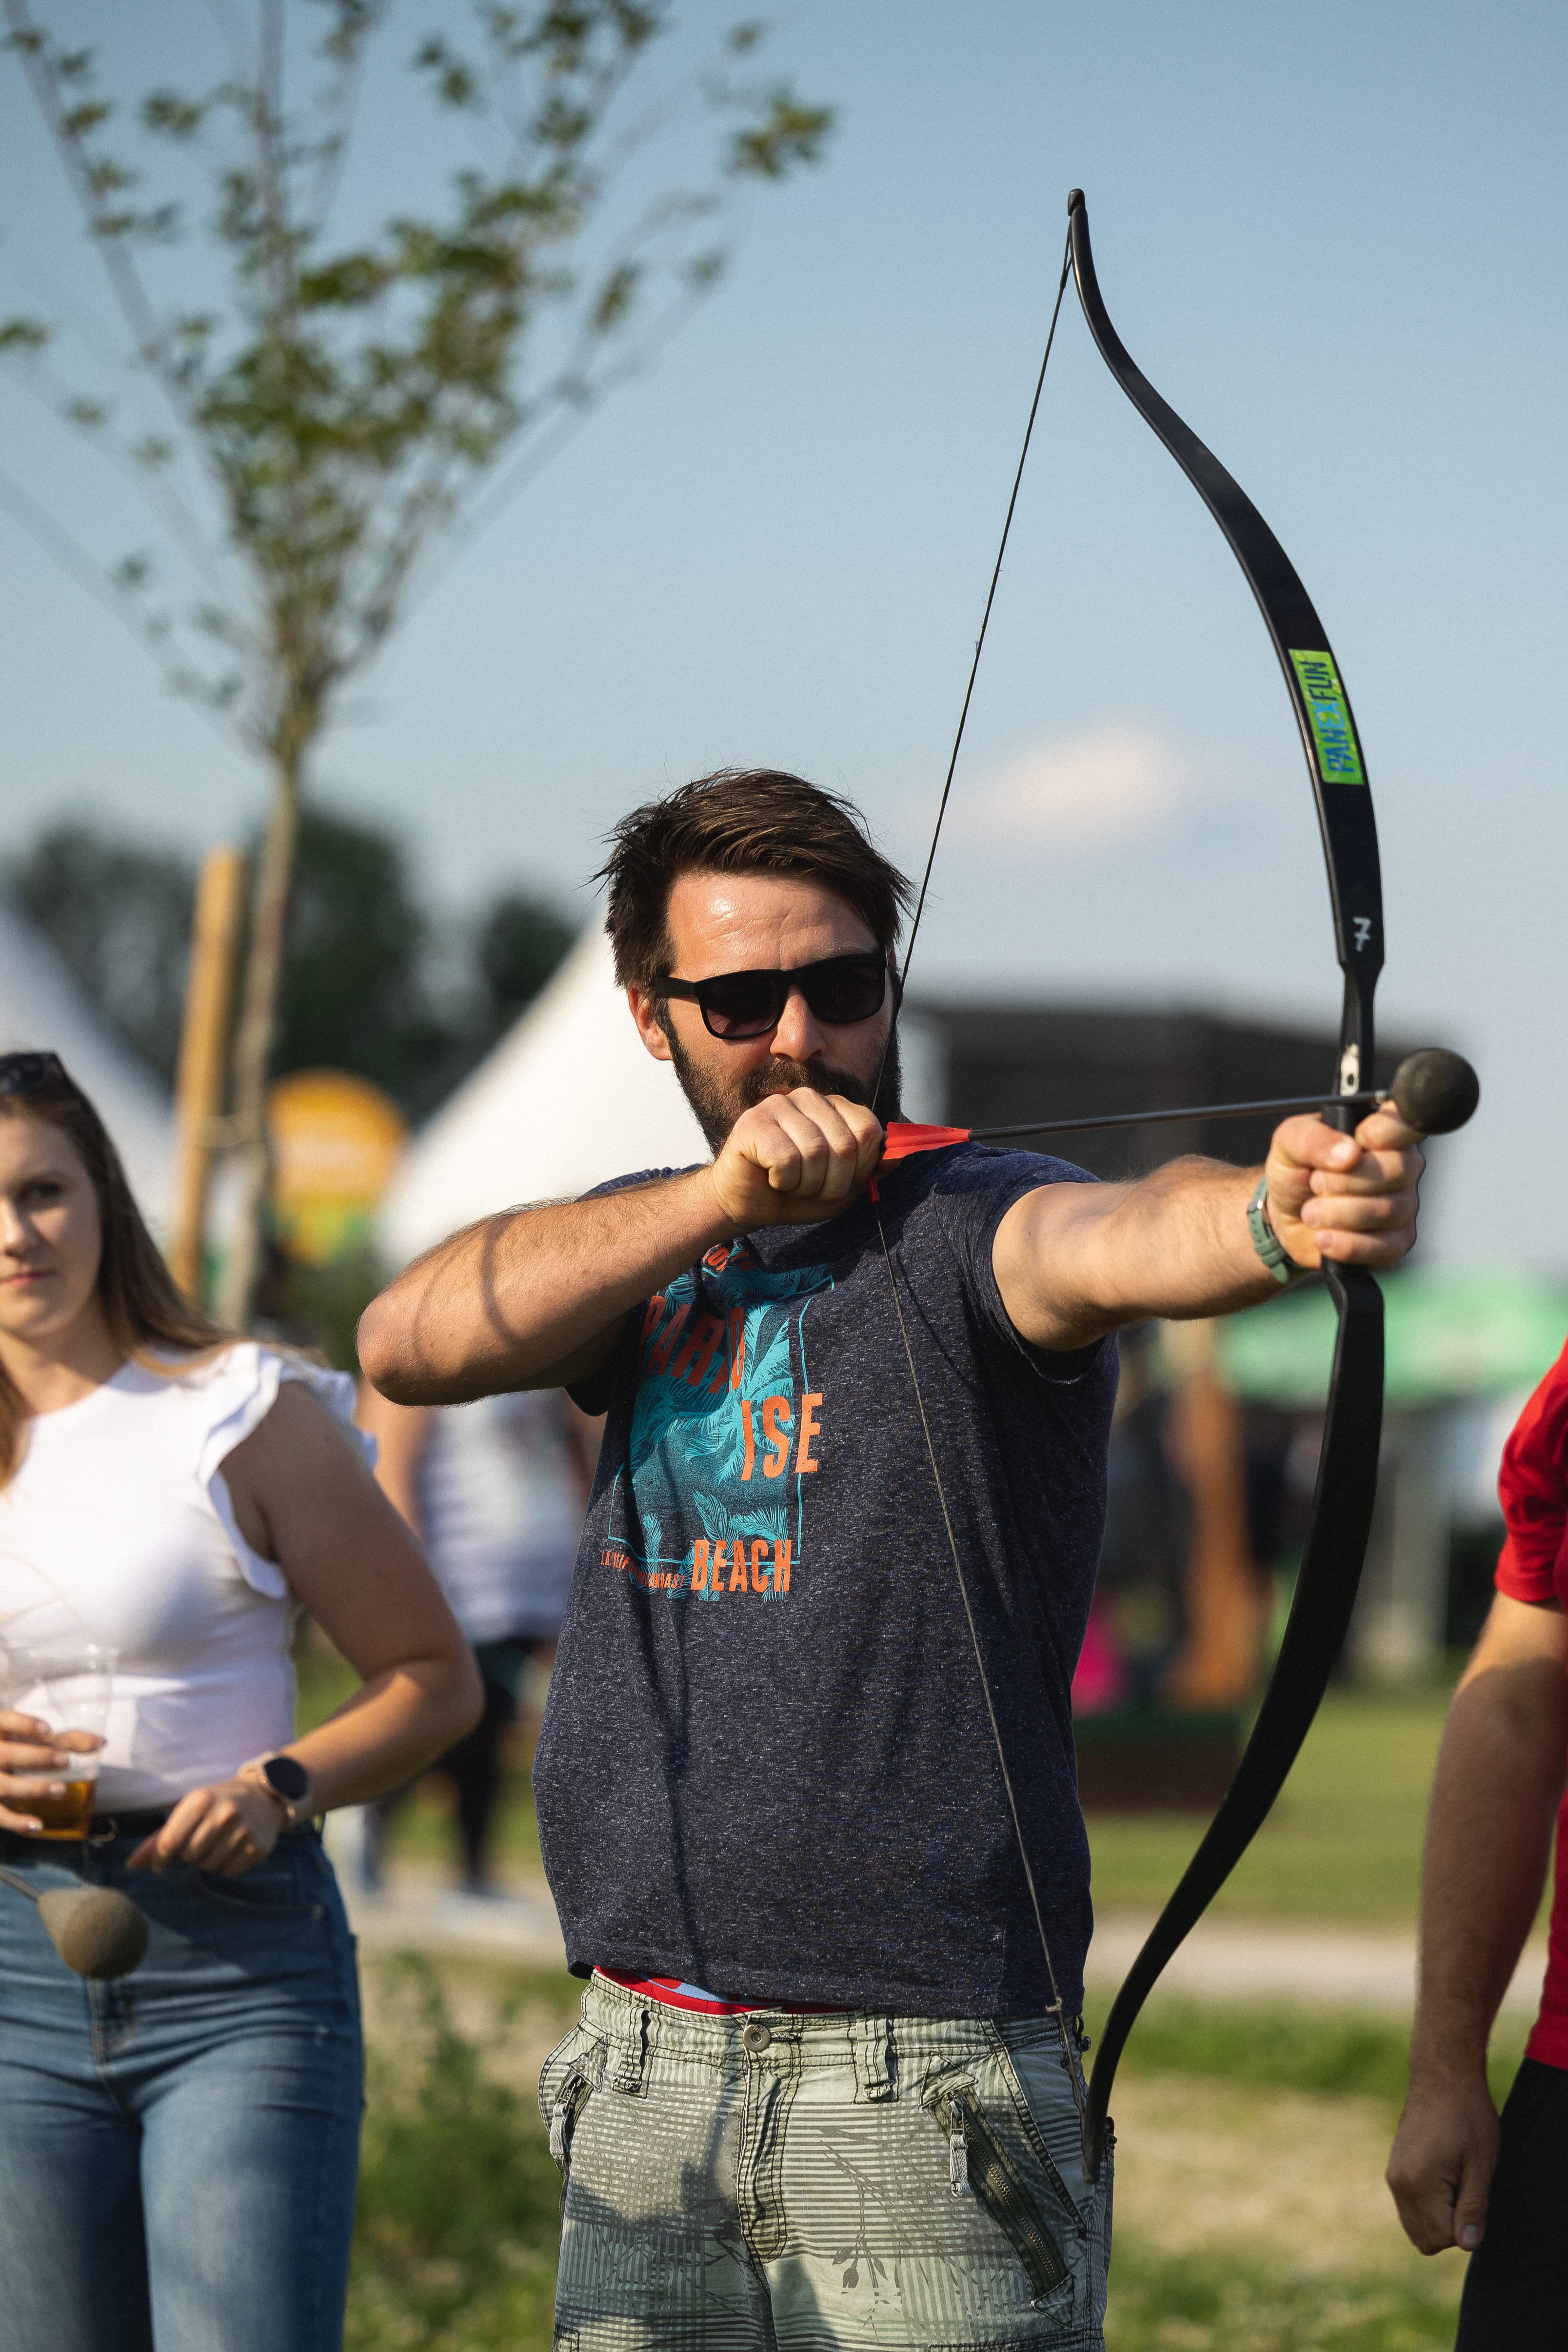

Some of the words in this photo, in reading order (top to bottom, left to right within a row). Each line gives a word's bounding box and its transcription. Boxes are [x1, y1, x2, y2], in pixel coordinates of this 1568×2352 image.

[1353, 917, 1371, 952] 7
[740, 1393, 823, 1481] ISE
[690, 1539, 792, 1593] BEACH
